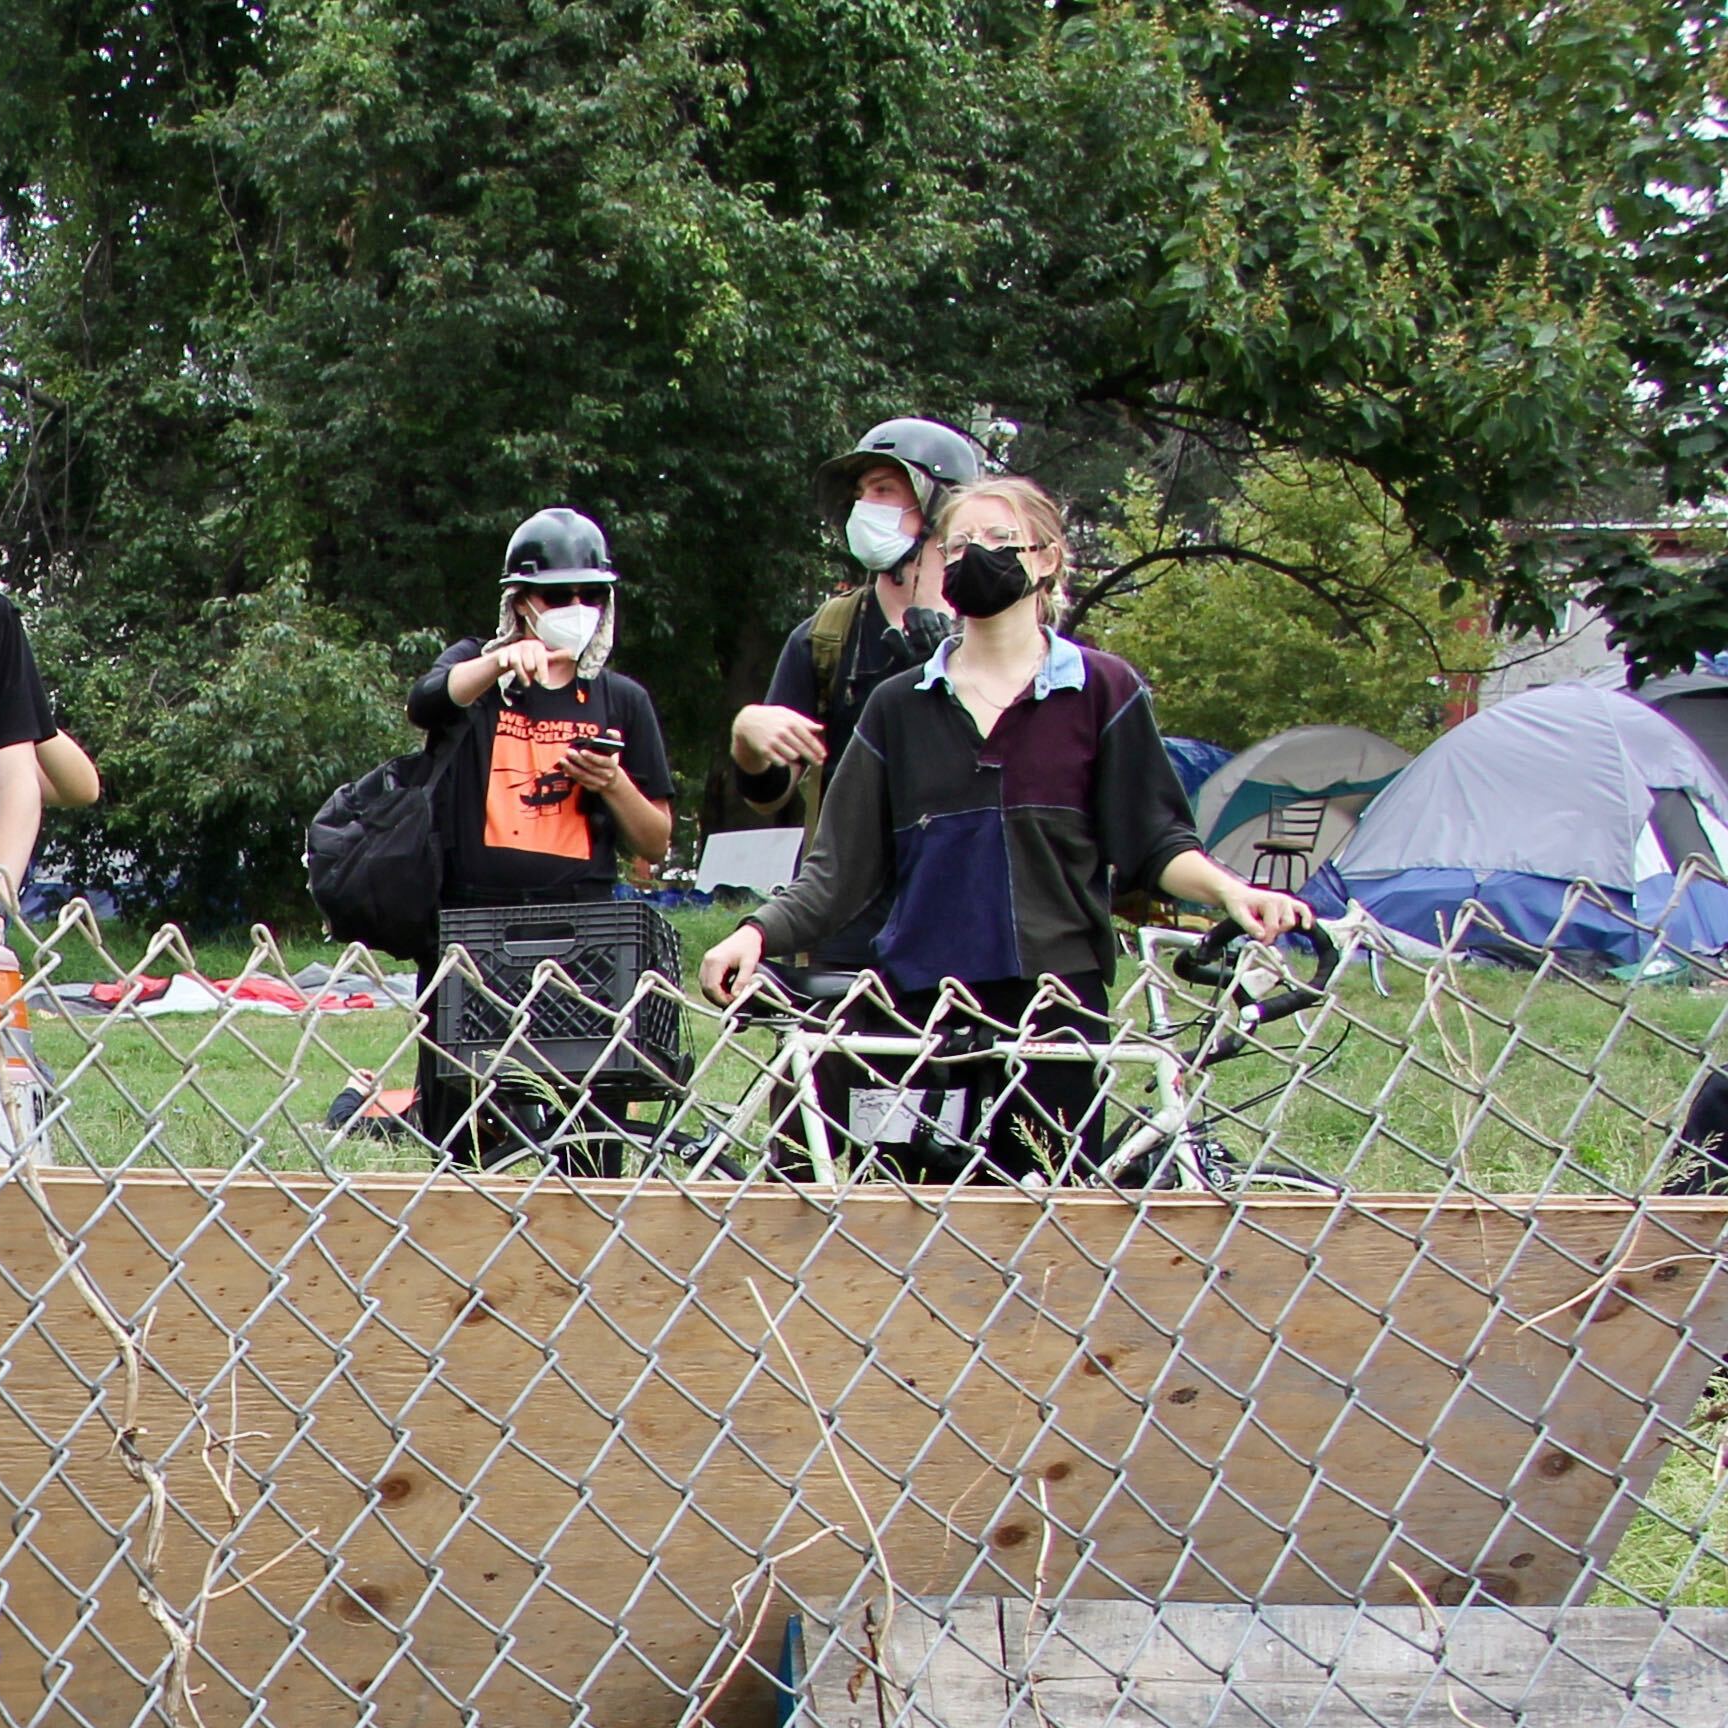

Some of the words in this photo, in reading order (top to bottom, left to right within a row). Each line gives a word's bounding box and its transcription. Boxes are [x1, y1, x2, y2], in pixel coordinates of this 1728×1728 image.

[496, 722, 597, 742] PHILDELP
[499, 710, 573, 732] WEOME
[575, 722, 599, 737] TO
